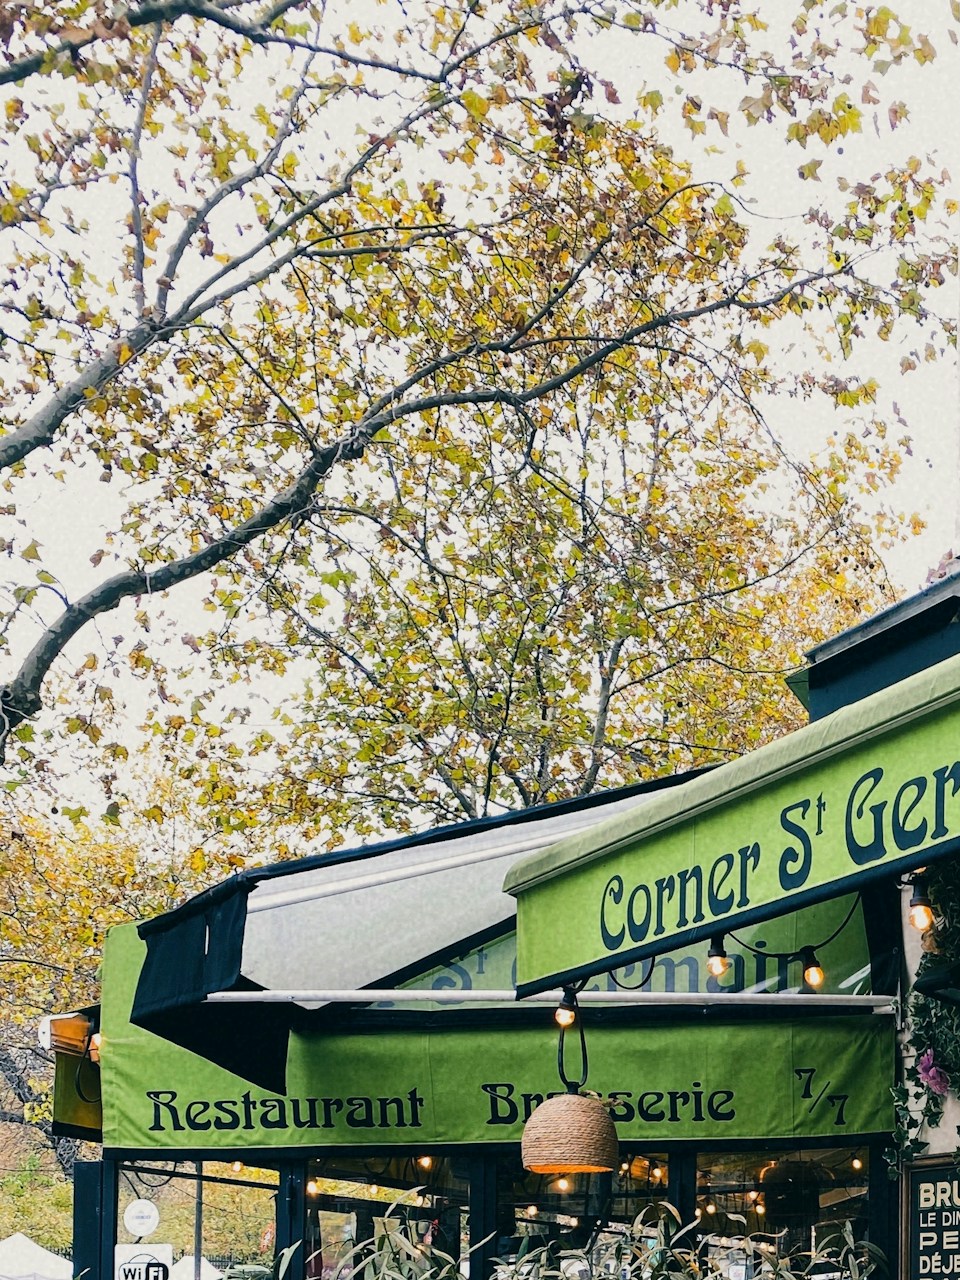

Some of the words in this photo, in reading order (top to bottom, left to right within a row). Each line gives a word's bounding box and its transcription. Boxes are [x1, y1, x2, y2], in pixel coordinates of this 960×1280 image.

[600, 841, 760, 950] Corner
[779, 791, 826, 891] St
[146, 1087, 425, 1132] Restaurant
[481, 1082, 737, 1125] Brserie
[794, 1068, 849, 1126] 7/7
[919, 1212, 937, 1228] LE
